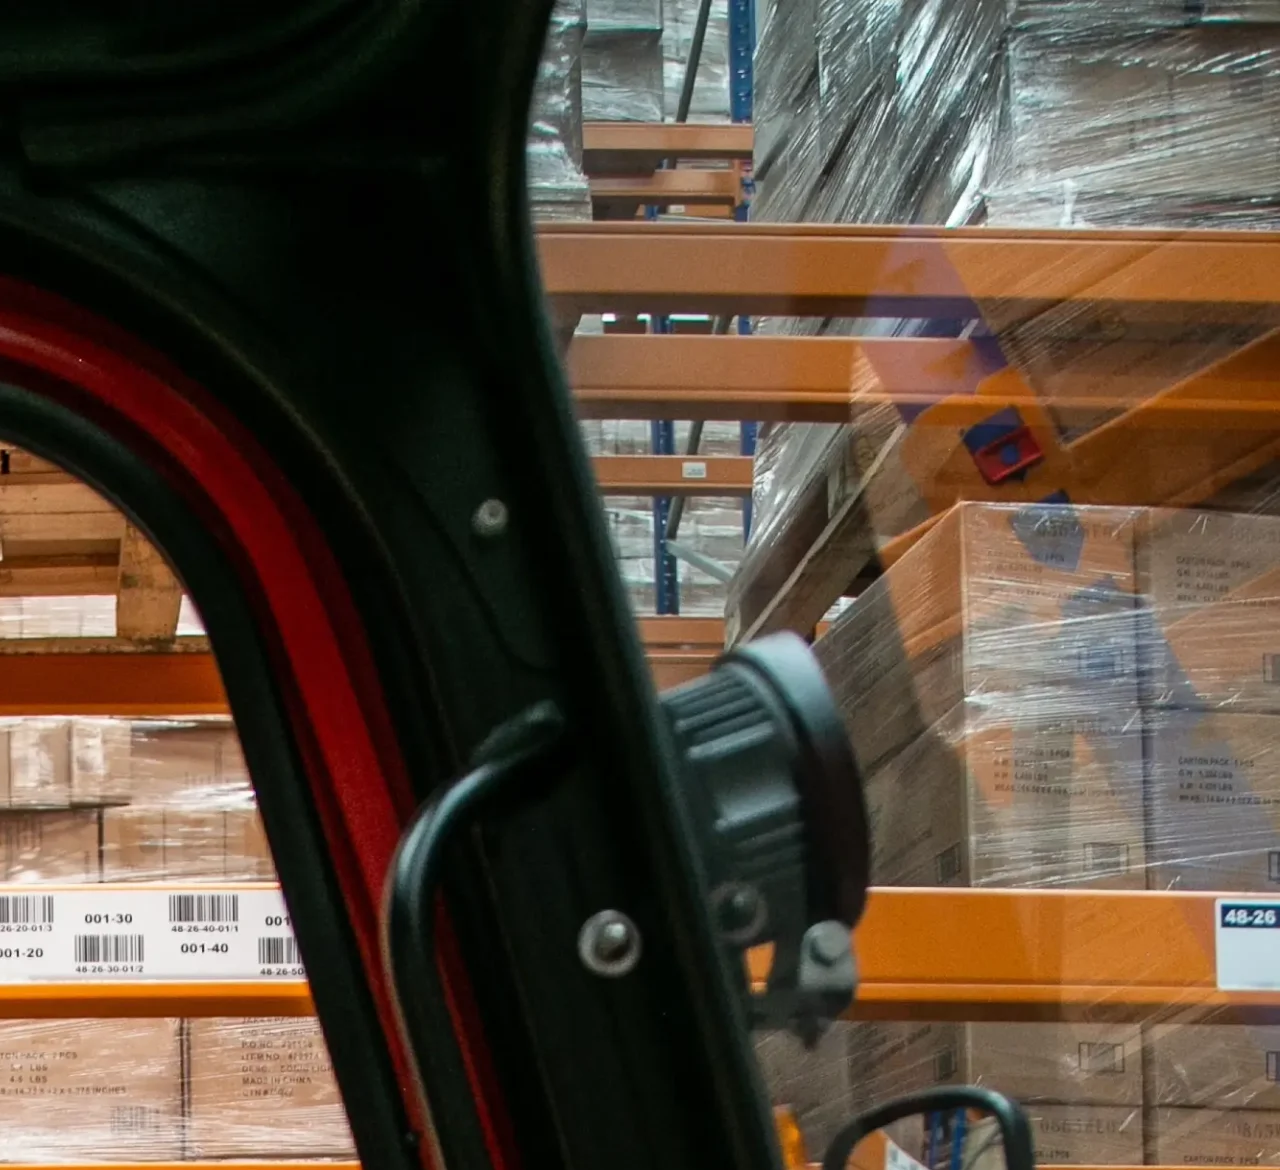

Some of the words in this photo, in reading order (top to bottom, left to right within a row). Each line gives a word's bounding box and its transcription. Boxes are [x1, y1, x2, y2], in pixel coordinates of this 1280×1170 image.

[84, 913, 133, 924] 001-30
[265, 916, 290, 926] 001
[1224, 908, 1276, 925] 48-26
[180, 943, 229, 953] 001-40
[260, 968, 304, 976] 48-26-50
